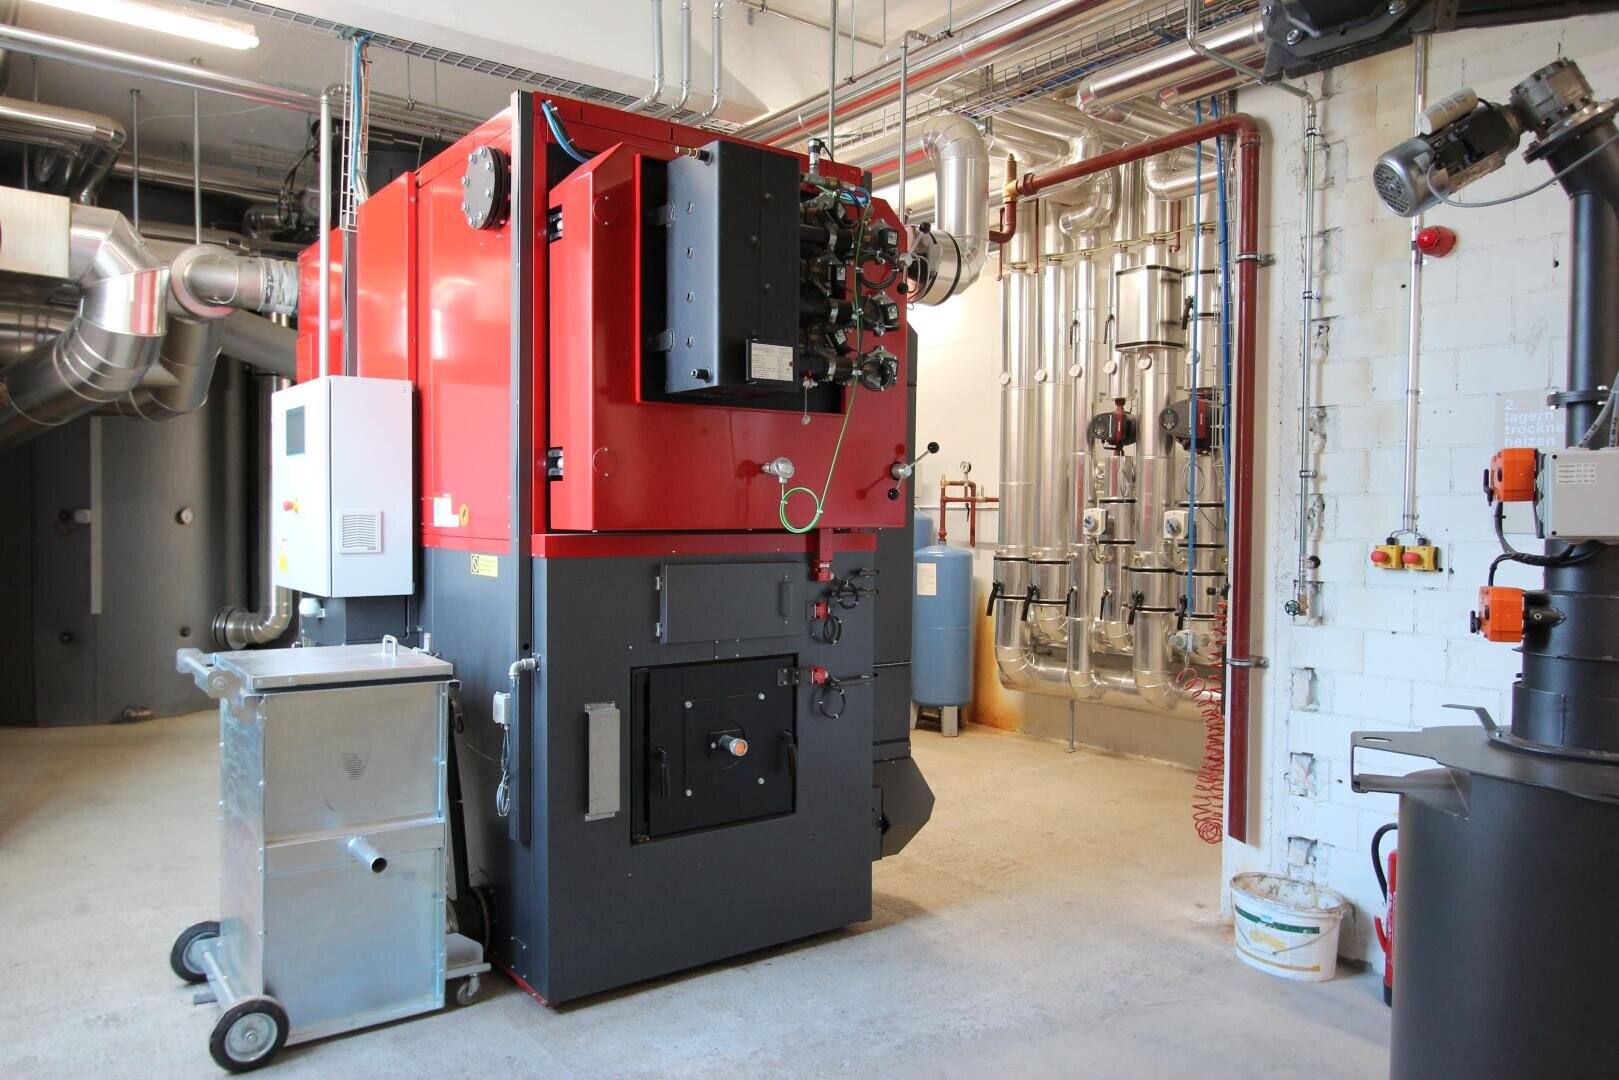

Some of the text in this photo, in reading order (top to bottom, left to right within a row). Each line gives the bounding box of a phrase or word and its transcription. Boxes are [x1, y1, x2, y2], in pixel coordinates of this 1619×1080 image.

[1504, 398, 1518, 410] 2.
[1504, 411, 1555, 425] lagern
[1504, 422, 1565, 435] trockne
[1504, 435, 1556, 447] heizen
